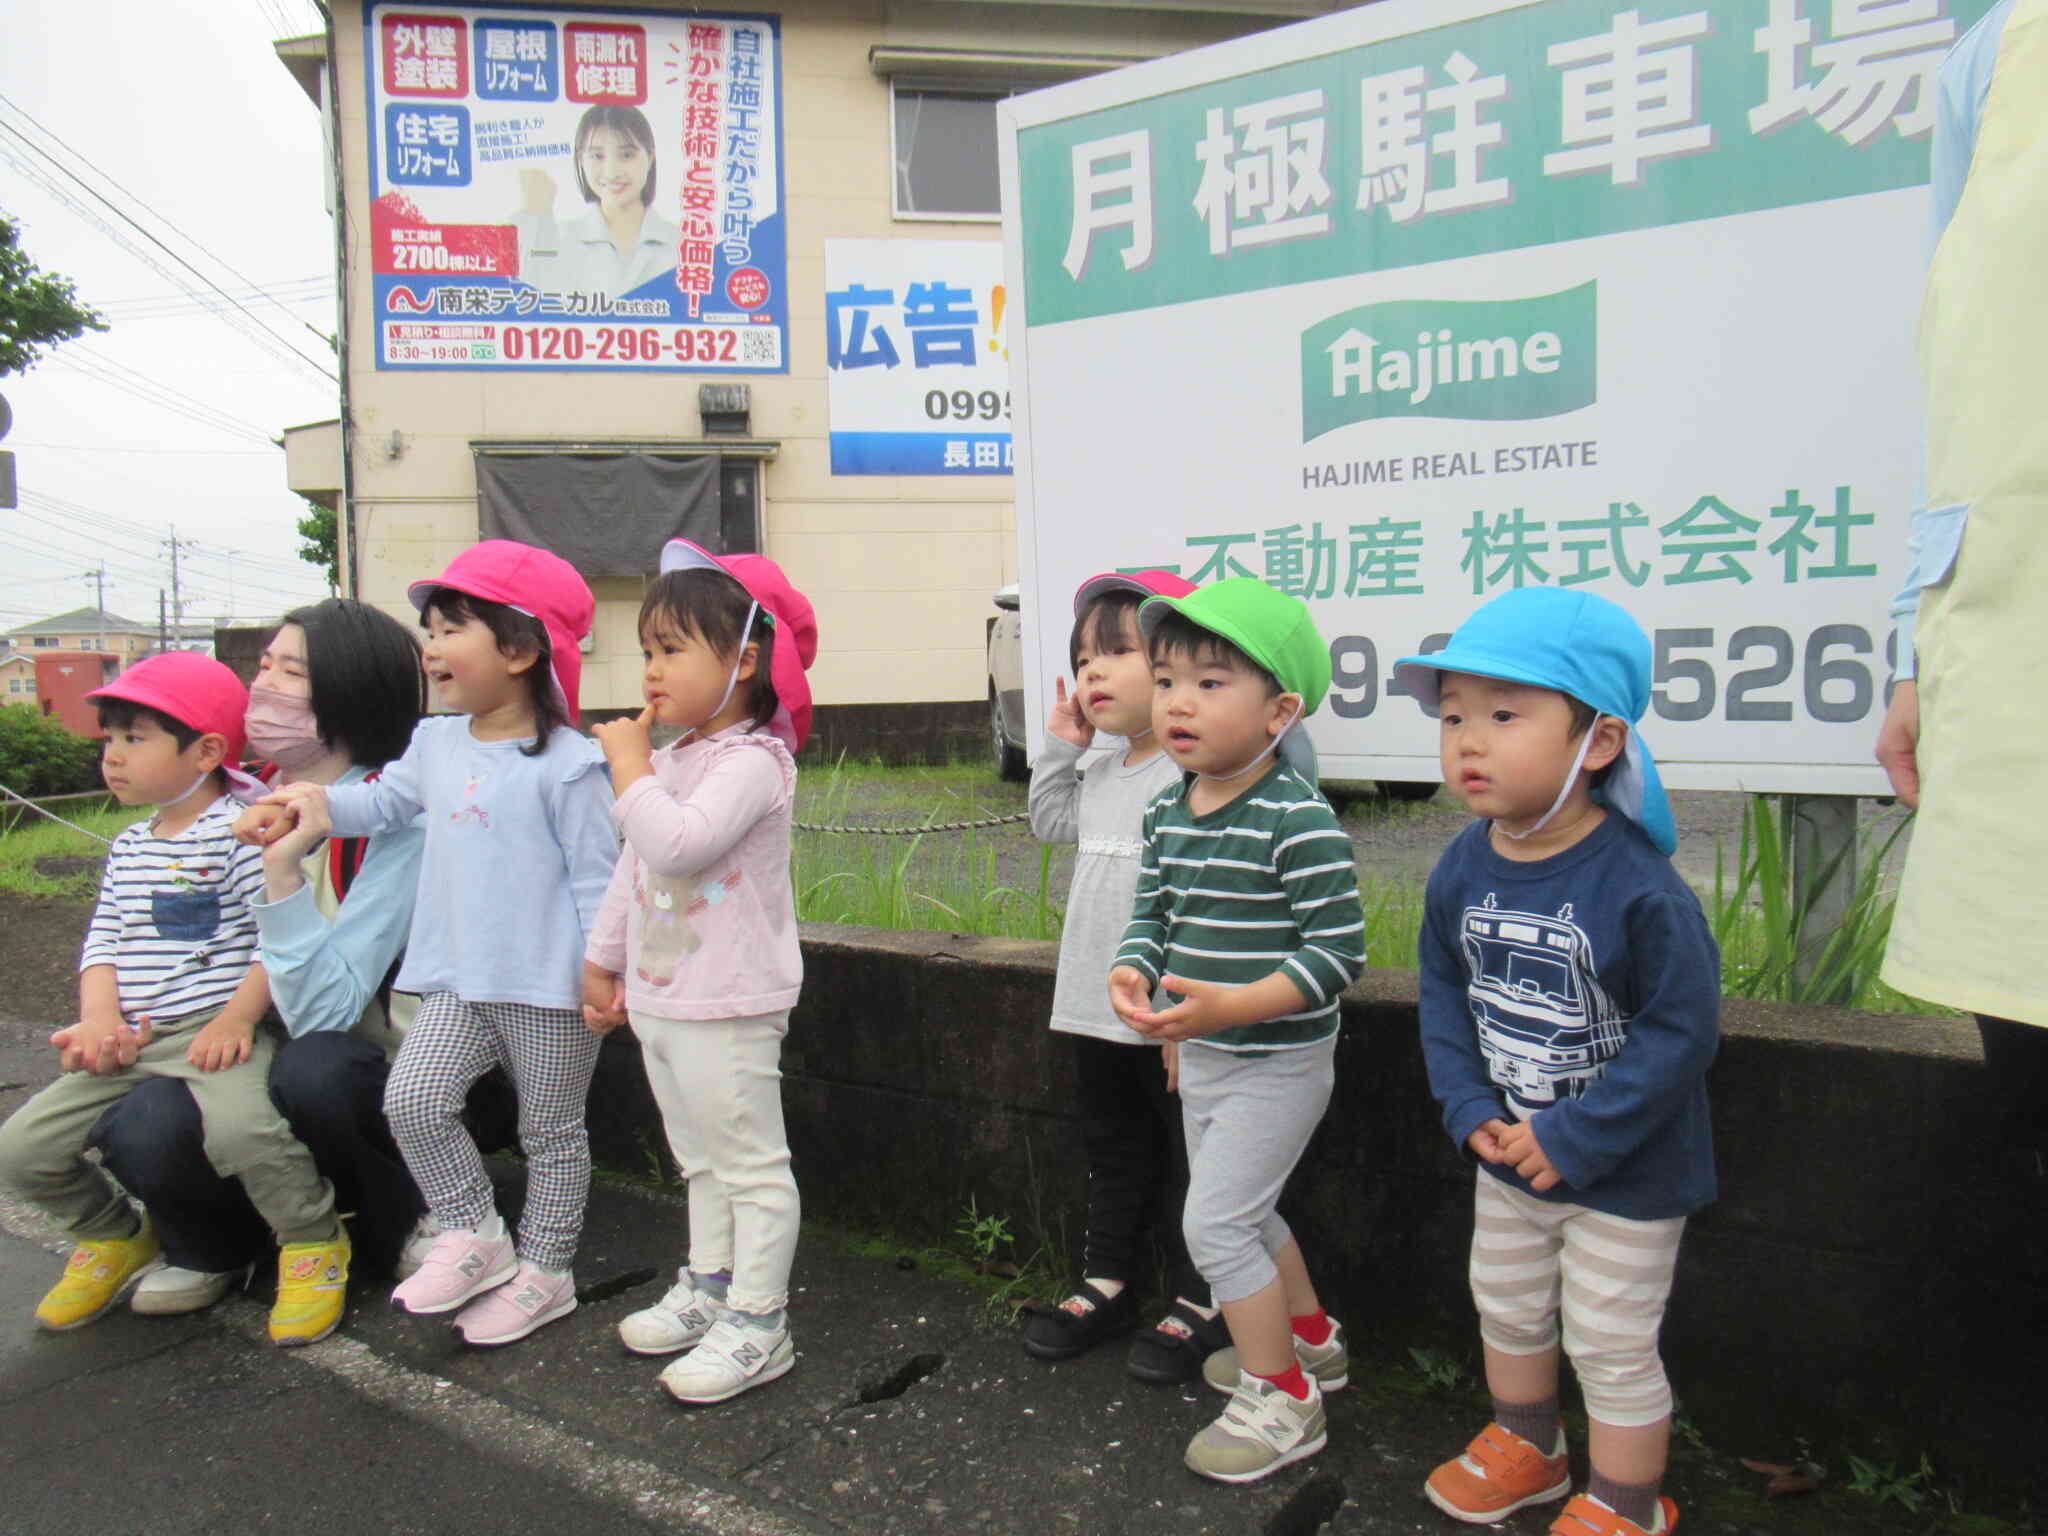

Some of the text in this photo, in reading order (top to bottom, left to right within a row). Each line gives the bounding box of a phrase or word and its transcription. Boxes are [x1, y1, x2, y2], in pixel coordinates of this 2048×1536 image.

[393, 24, 457, 57] 外壁
[485, 28, 547, 61] 屋根
[574, 31, 638, 64] 雨漏れ
[394, 56, 458, 89] 塗装
[485, 62, 548, 92] リフォーム
[575, 64, 638, 97] 修理
[396, 112, 460, 146] 住宅
[1062, 0, 1955, 282] 月極駐車場
[397, 146, 460, 177] リフォーム
[723, 28, 761, 264] 自社施工だから叶う
[503, 326, 737, 362] 0120-296-932
[1325, 327, 1562, 404] Hajime
[1303, 440, 1598, 490] HAJIME REAL ESTATE
[1460, 485, 1878, 596] 株式会社
